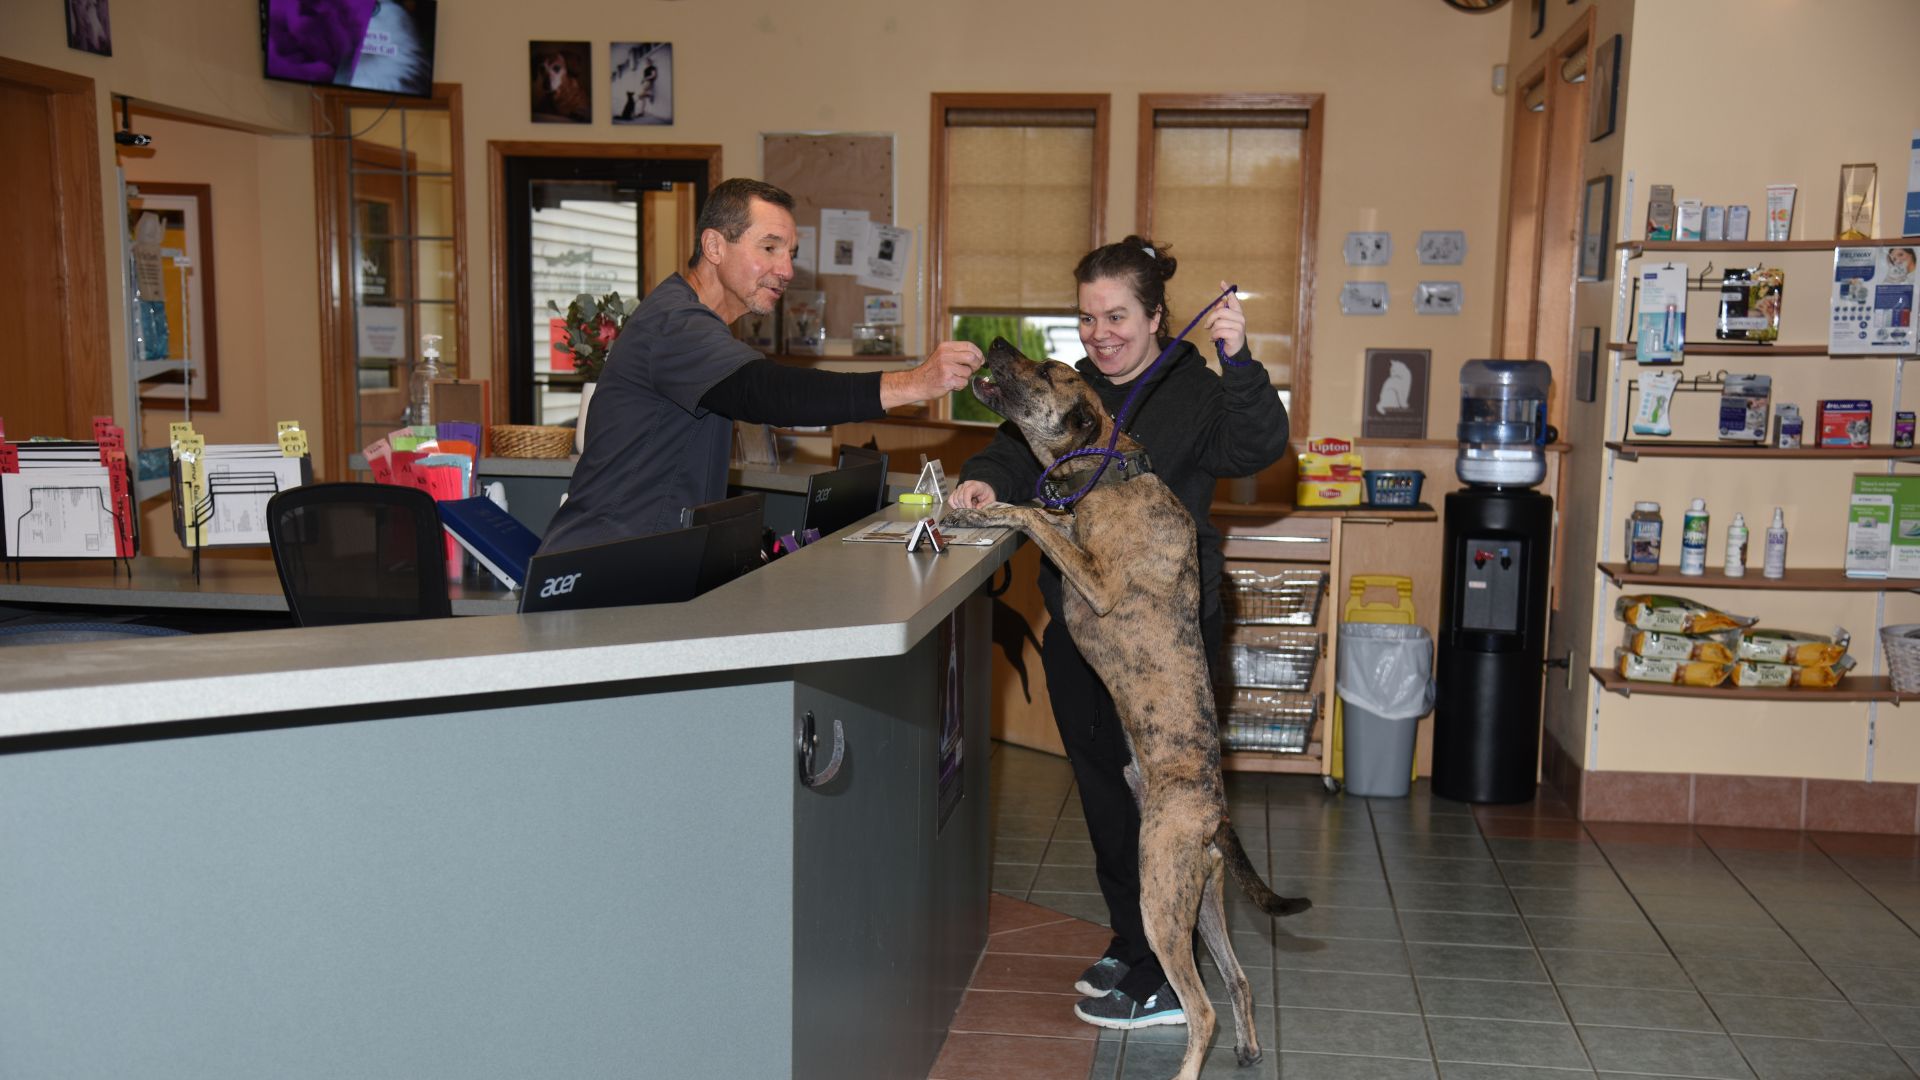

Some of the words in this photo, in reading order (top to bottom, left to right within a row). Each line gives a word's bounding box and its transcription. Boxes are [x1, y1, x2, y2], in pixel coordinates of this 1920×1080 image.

[1312, 443, 1349, 454] Lipton
[815, 487, 832, 503] acer
[540, 572, 582, 598] acer
